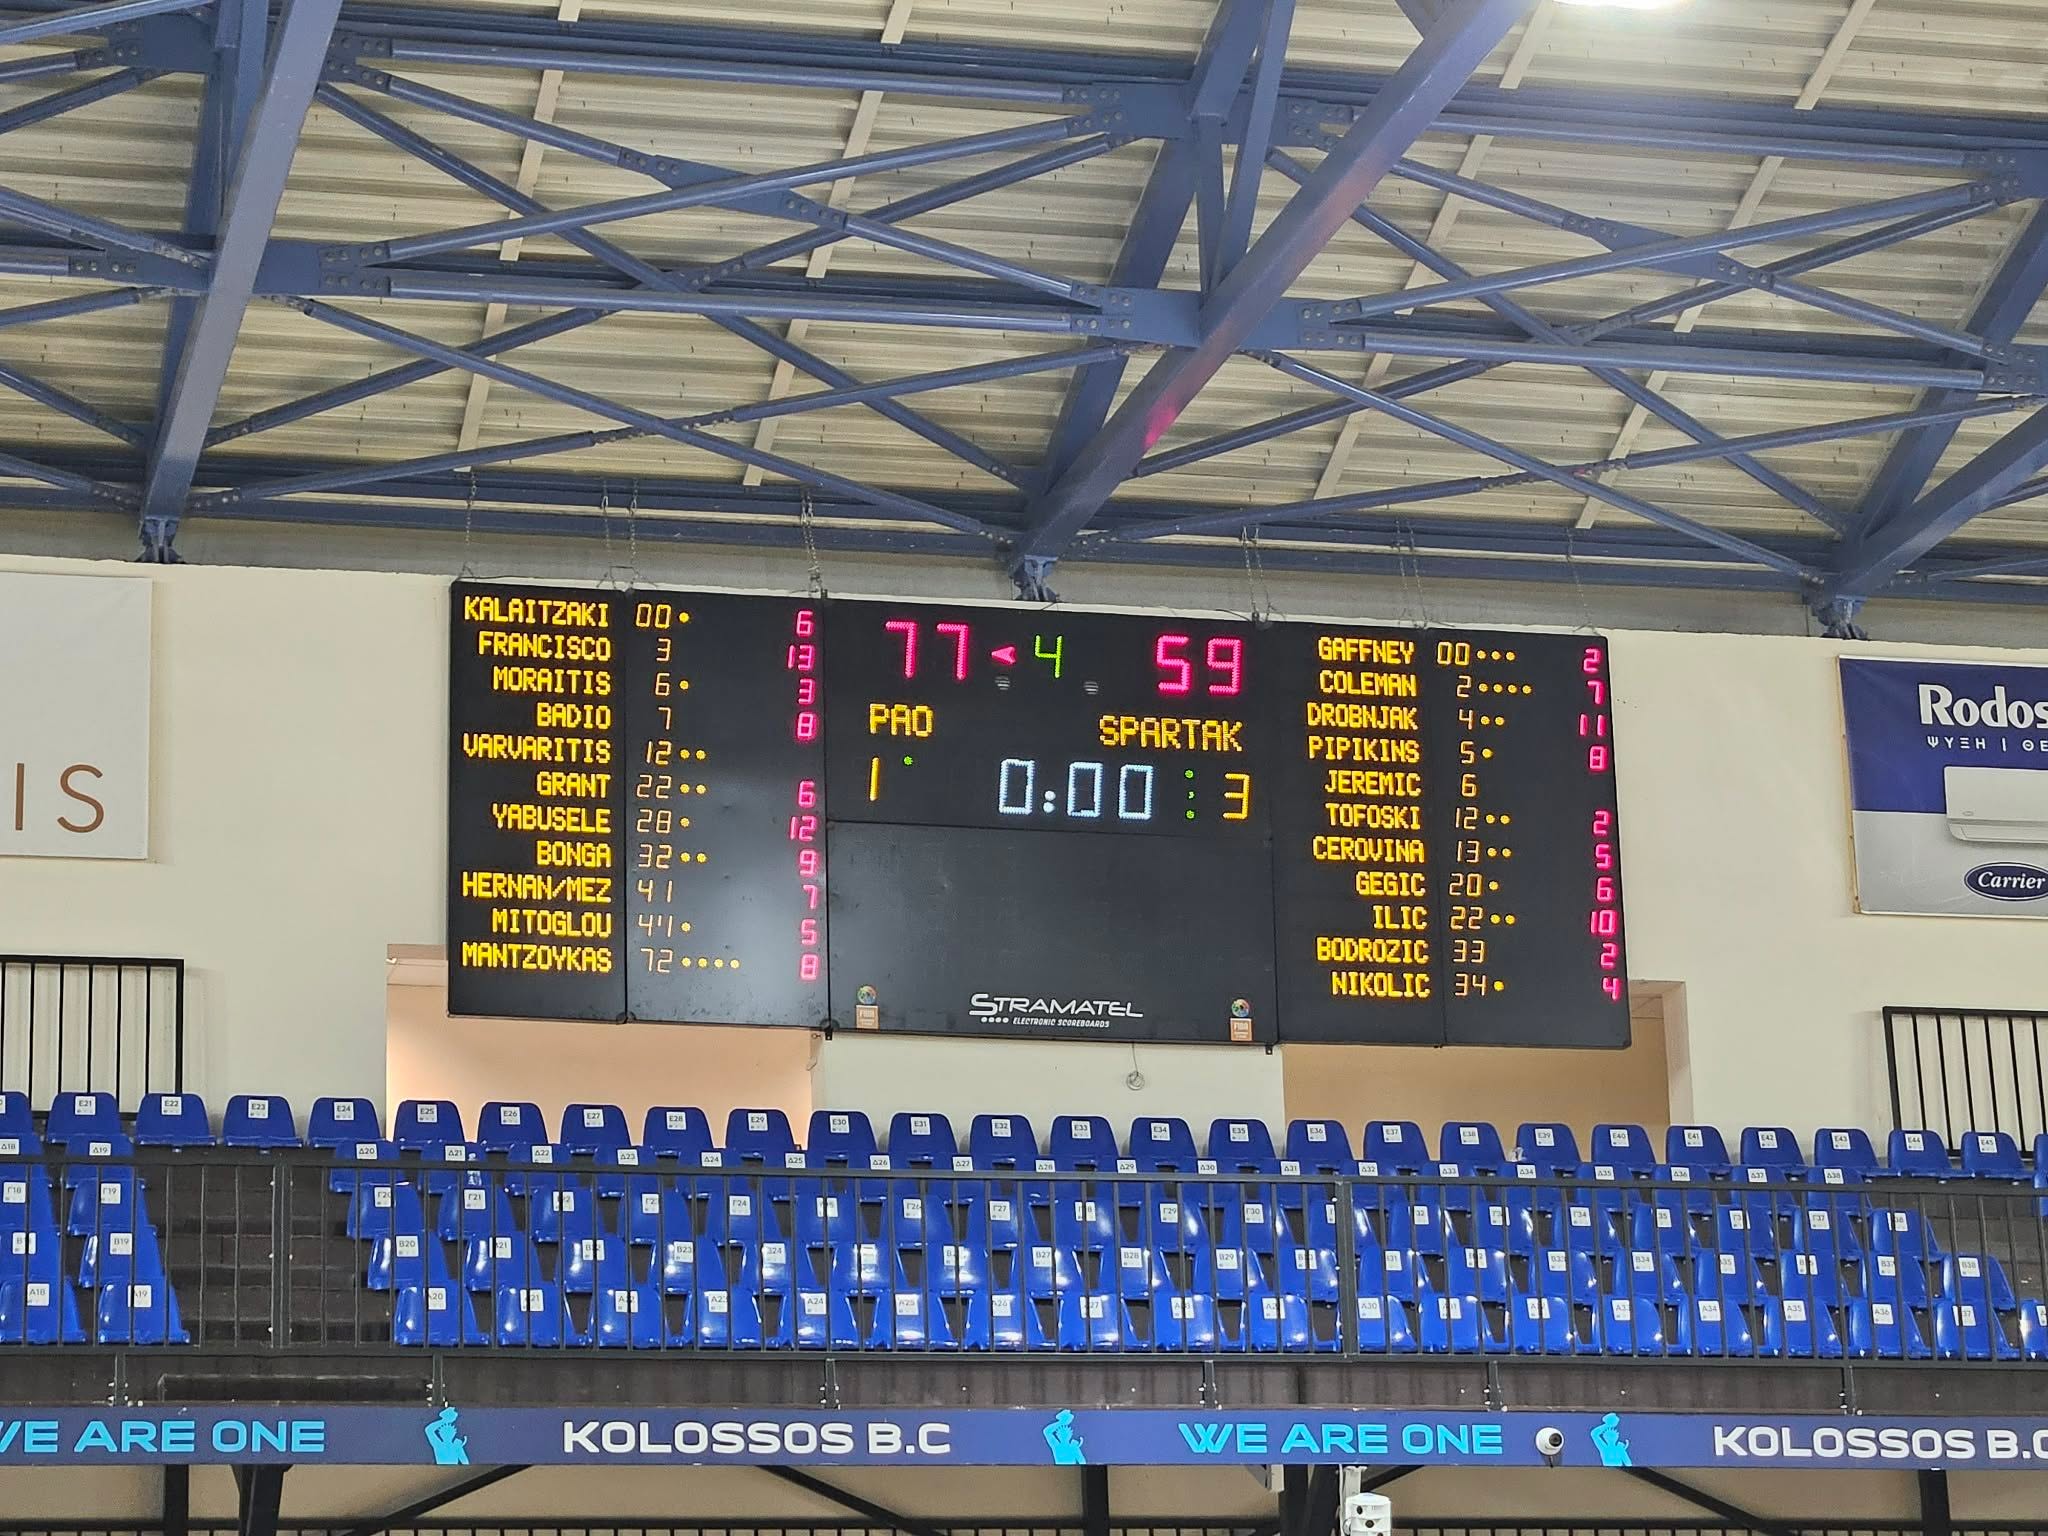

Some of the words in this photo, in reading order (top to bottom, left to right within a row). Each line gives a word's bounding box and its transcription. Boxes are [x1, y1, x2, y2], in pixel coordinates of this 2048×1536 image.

[464, 596, 609, 627] KALAITZAKI
[635, 603, 671, 629] 00
[796, 610, 814, 636] 6
[478, 631, 611, 662] FRANCISCO
[656, 638, 671, 662] 3
[787, 644, 815, 670] 13
[885, 620, 970, 680] 77
[1033, 634, 1063, 679] 4
[1155, 634, 1243, 696] 59
[1318, 636, 1414, 664] GAFFNEY
[1436, 641, 1470, 666] 00
[1583, 648, 1600, 673] 2
[493, 666, 611, 694] MORAITIS
[655, 673, 670, 696] 6
[798, 678, 815, 705] 3
[1319, 670, 1416, 697] COLEMAN
[1457, 675, 1472, 698] 2
[1587, 680, 1602, 705] 7
[536, 703, 611, 729] BADIO
[658, 706, 671, 730] 7
[797, 712, 816, 739] 8
[868, 703, 933, 738] PAO
[1099, 714, 1244, 752] SPARTAK
[1306, 702, 1418, 730] DROBNJAK
[1458, 709, 1473, 730] 4
[1579, 713, 1604, 736] 11
[463, 733, 611, 763] VARVARITIS
[646, 740, 671, 765] 12
[1308, 735, 1420, 763] PIPIKINS
[1460, 741, 1475, 764] 5
[1589, 746, 1607, 771] 8
[1927, 735, 1986, 750] ΨΥΞΗ
[536, 771, 611, 799] GRANT
[636, 774, 672, 799] 22
[797, 781, 815, 808] 6
[869, 756, 880, 801] 1
[998, 758, 1154, 820] 0:00
[1223, 772, 1250, 820] 3
[1324, 769, 1421, 797] JEREMIC
[1461, 773, 1477, 797] 6
[492, 803, 611, 834] YABUSELE
[636, 809, 672, 834] 28
[789, 816, 816, 841] 12
[1325, 803, 1421, 829] TOFOSKI
[1455, 807, 1478, 829] 12
[1593, 810, 1610, 836] 2
[536, 840, 612, 868] BONGA
[638, 844, 672, 868] 32
[799, 849, 816, 876] 9
[1312, 836, 1425, 863] CEROVINA
[1457, 840, 1480, 863] 13
[1595, 844, 1611, 869] 5
[462, 871, 612, 903] HERNAN/MEZ
[637, 879, 673, 903] 41
[802, 884, 817, 909] 7
[1355, 871, 1426, 897] GEGIC
[1449, 873, 1483, 897] 20
[1597, 877, 1612, 902] 6
[1977, 871, 2046, 889] Carrier
[492, 908, 612, 938] MITOGLOU
[800, 919, 817, 945] 5
[1372, 904, 1428, 930] ILIC
[1450, 906, 1484, 930] 22
[1590, 909, 1616, 936] 10
[462, 941, 612, 973] MANTZOYKAS
[640, 948, 673, 973] 72
[800, 954, 818, 980] 8
[1316, 937, 1429, 964] BODROZIC
[1453, 940, 1485, 964] 33
[1601, 942, 1618, 968] 2
[1331, 971, 1430, 998] NIKOLIC
[1455, 973, 1487, 997] 34
[1602, 977, 1619, 1001] 4
[969, 993, 1143, 1018] STRAMATEL
[1012, 1017, 1056, 1026] ELECTRONIC
[1057, 1018, 1110, 1028] SCOREBOARDS
[74, 1420, 195, 1453] ARE
[212, 1420, 325, 1453] ONE
[563, 1421, 854, 1455] KOLOSSOS
[867, 1422, 951, 1455] B.C
[1178, 1423, 1268, 1454] WE
[1280, 1423, 1388, 1454] ARE
[1401, 1424, 1503, 1455] ONE
[1713, 1426, 1976, 1460] KOLOSSOS
